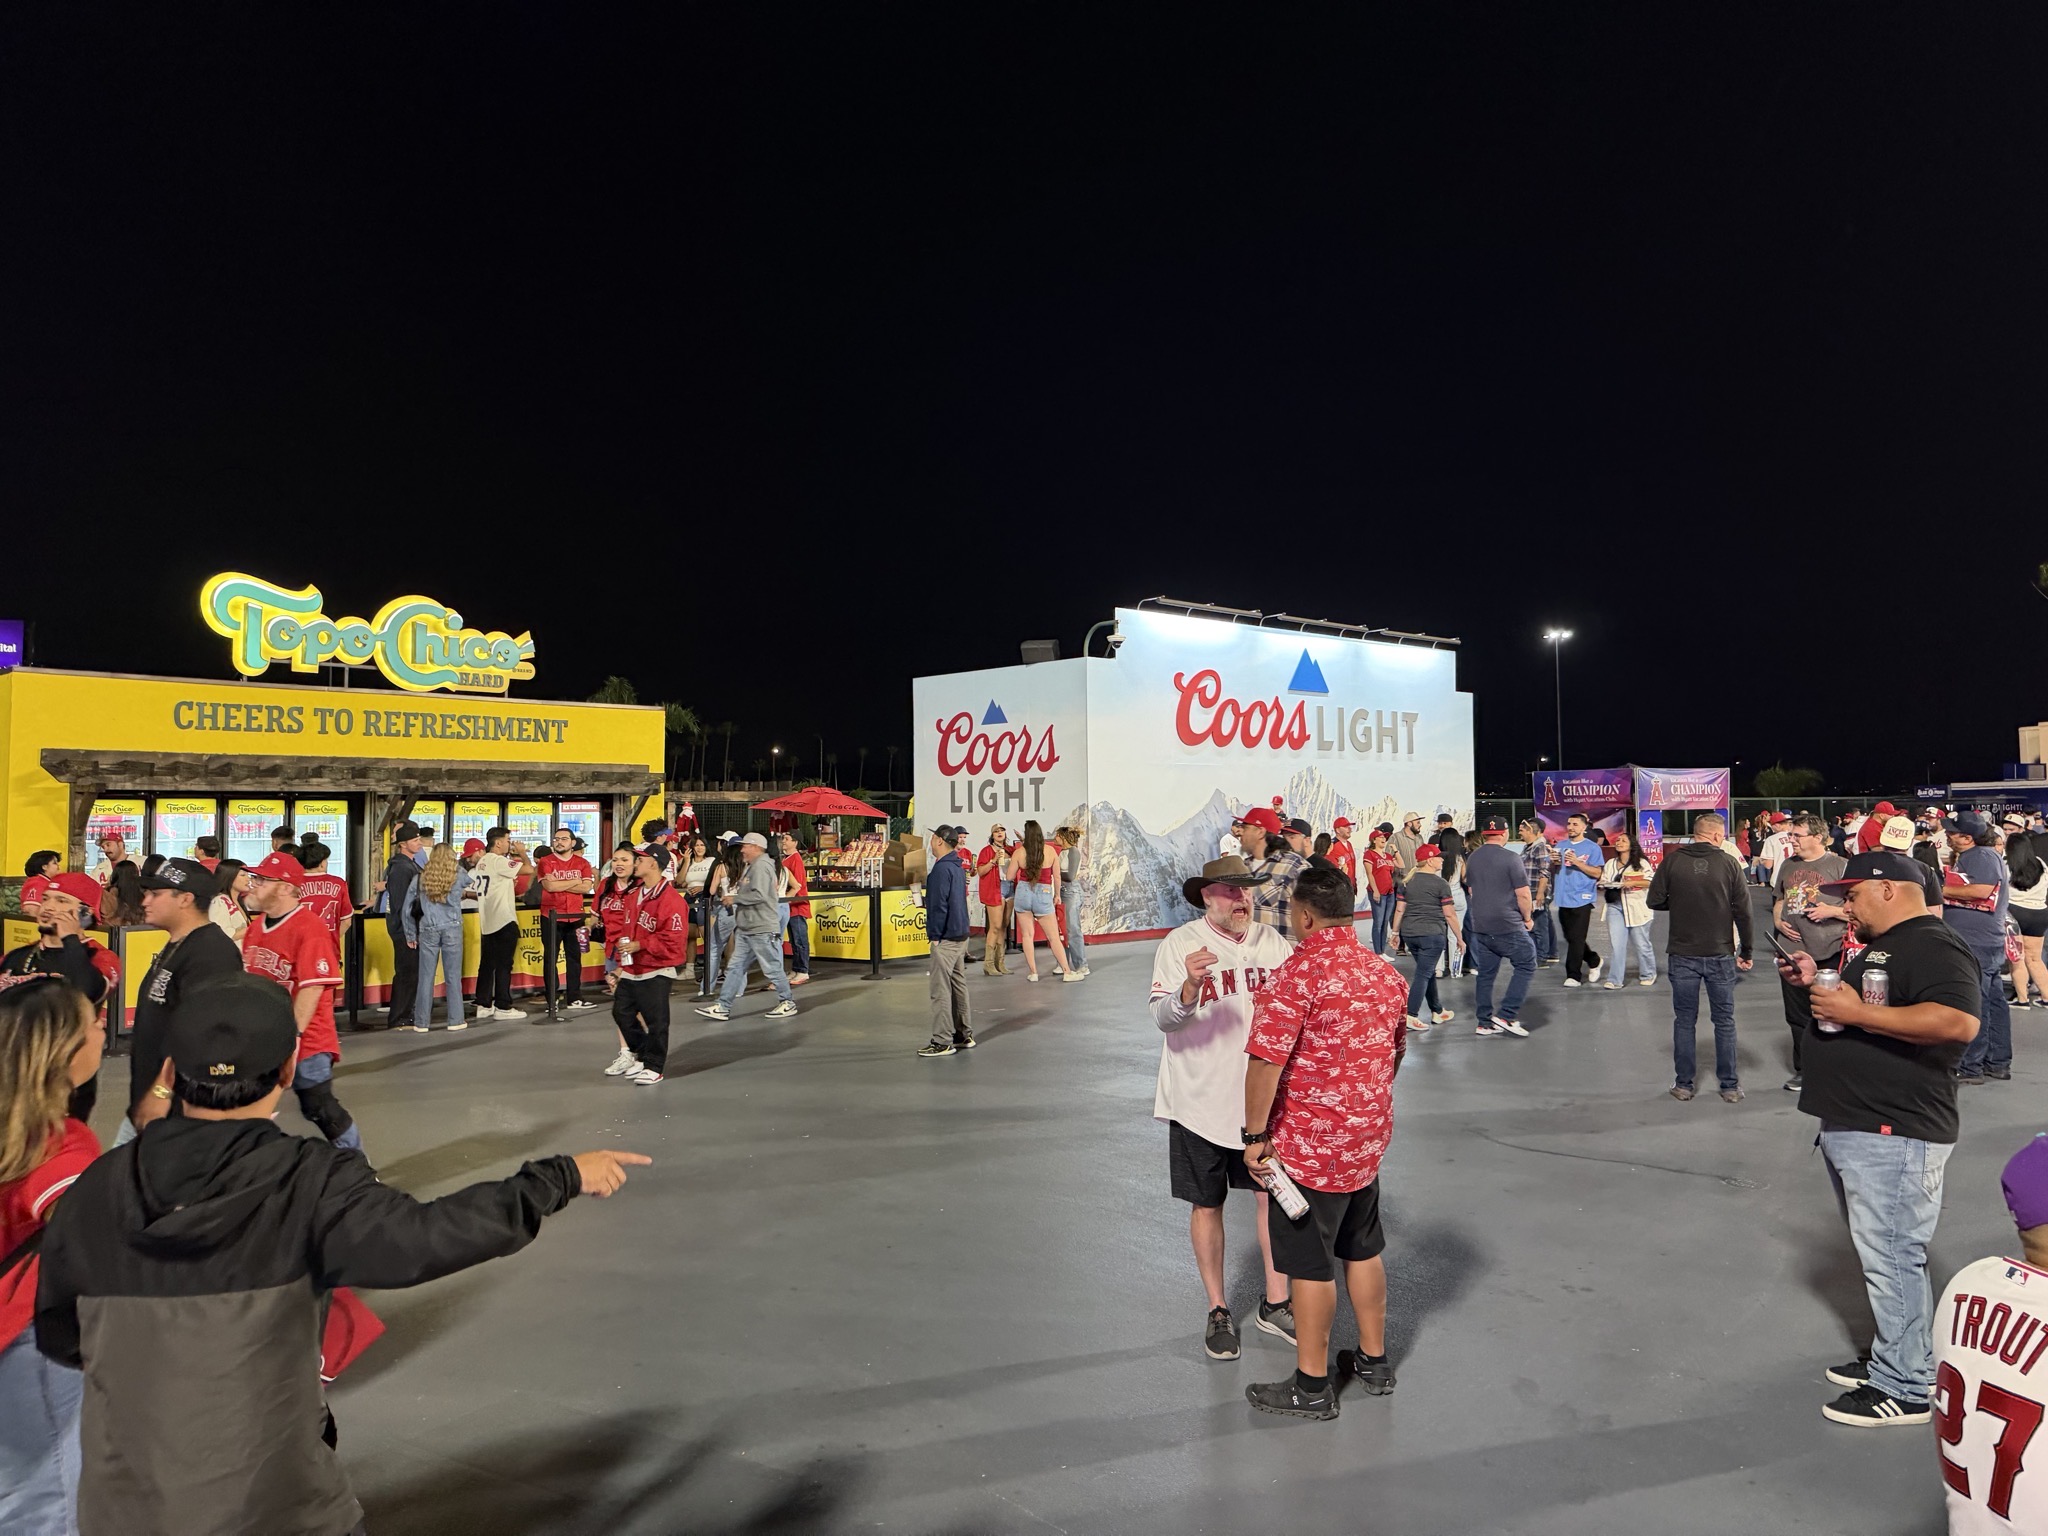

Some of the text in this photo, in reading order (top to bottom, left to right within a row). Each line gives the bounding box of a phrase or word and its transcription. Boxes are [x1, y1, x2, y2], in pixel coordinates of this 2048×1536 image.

[213, 578, 535, 686] Topo Chico
[458, 672, 504, 688] HARD
[1173, 669, 1419, 755] Coors LIGHT
[173, 701, 569, 743] CHEERS TO REFRESHMENT
[936, 711, 1060, 777] Coors
[950, 777, 1046, 813] LIGHT
[1562, 784, 1621, 796] CHAMPION
[1670, 783, 1722, 795] CHAMPION
[93, 804, 135, 814] Topo Chico
[166, 803, 207, 814] Topo Chico
[238, 804, 276, 814] Topo Chico
[303, 804, 339, 814] Topo Chico
[299, 881, 341, 899] RUMBO
[815, 914, 861, 933] Topo Chico
[890, 912, 927, 931] Topo Chi
[822, 935, 855, 945] HARD SELTZER
[898, 932, 927, 943] HARD SELTZ
[1199, 967, 1270, 1010] ANGE
[1863, 991, 1885, 1001] ors
[1951, 1293, 2048, 1376] TROUT
[1935, 1360, 2046, 1522] 27
